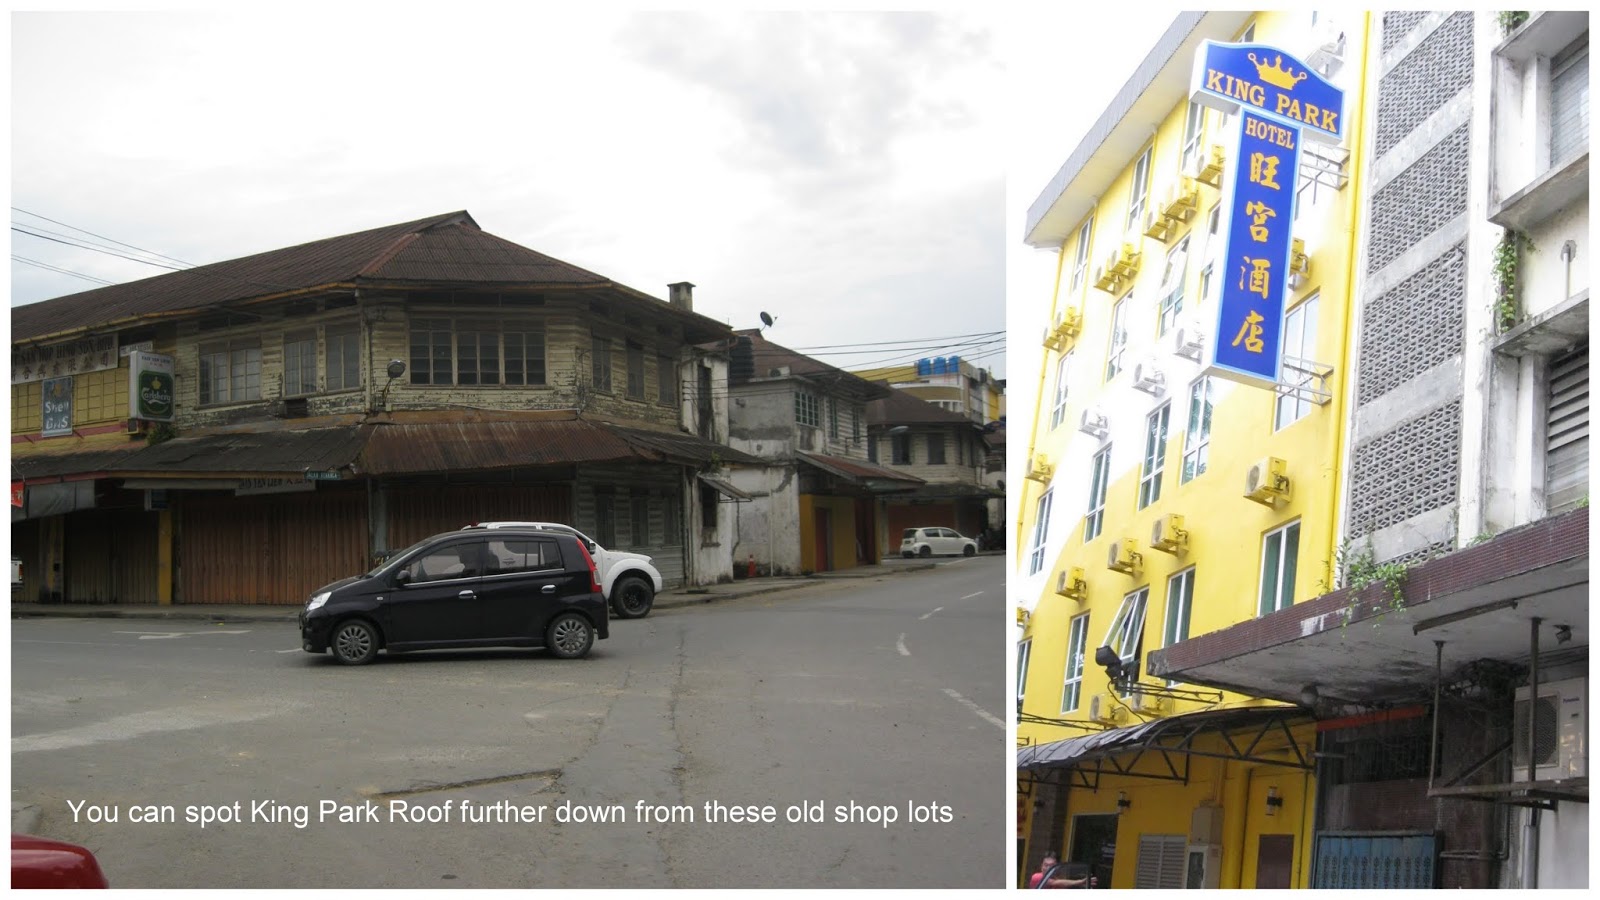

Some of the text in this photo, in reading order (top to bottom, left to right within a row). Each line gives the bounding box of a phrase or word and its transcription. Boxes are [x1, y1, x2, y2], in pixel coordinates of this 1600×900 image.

[1205, 68, 1338, 133] KING PARK
[1245, 117, 1295, 150] HOTEL
[45, 401, 69, 413] Shell
